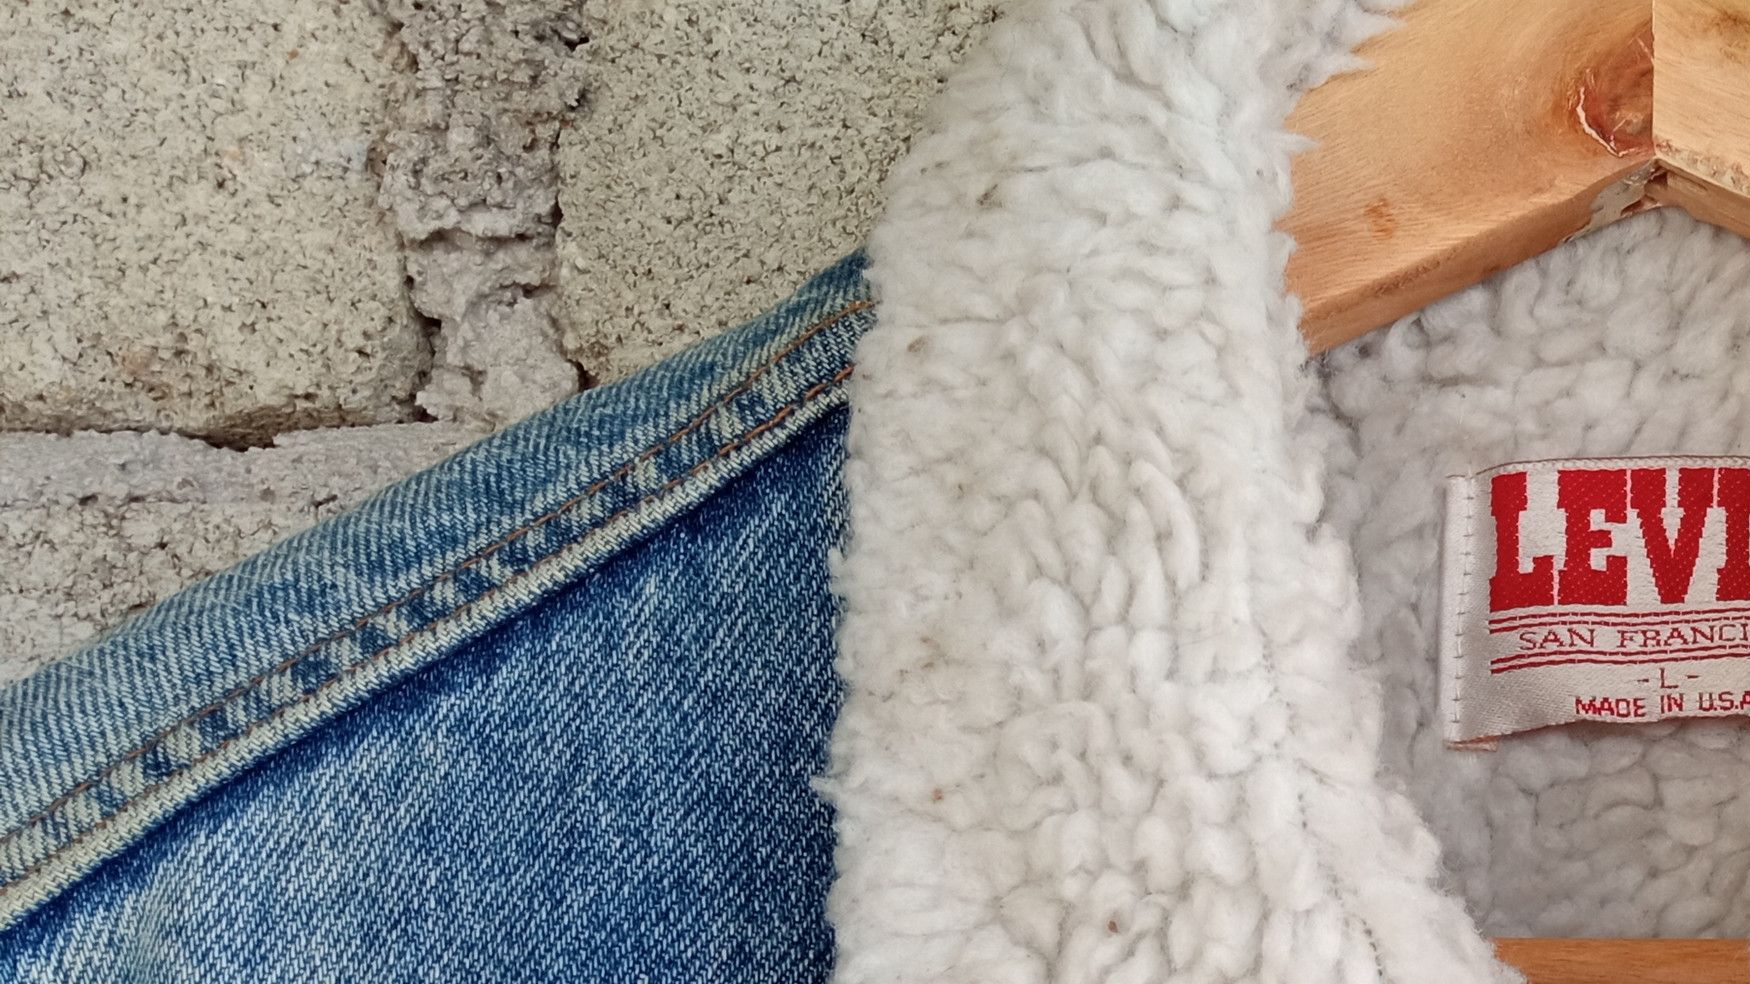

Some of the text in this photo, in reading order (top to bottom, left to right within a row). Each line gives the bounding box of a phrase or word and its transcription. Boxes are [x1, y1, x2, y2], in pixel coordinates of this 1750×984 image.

[1518, 627, 1595, 651] SAN
[1575, 697, 1646, 718] MADE
[1660, 693, 1684, 714] IN
